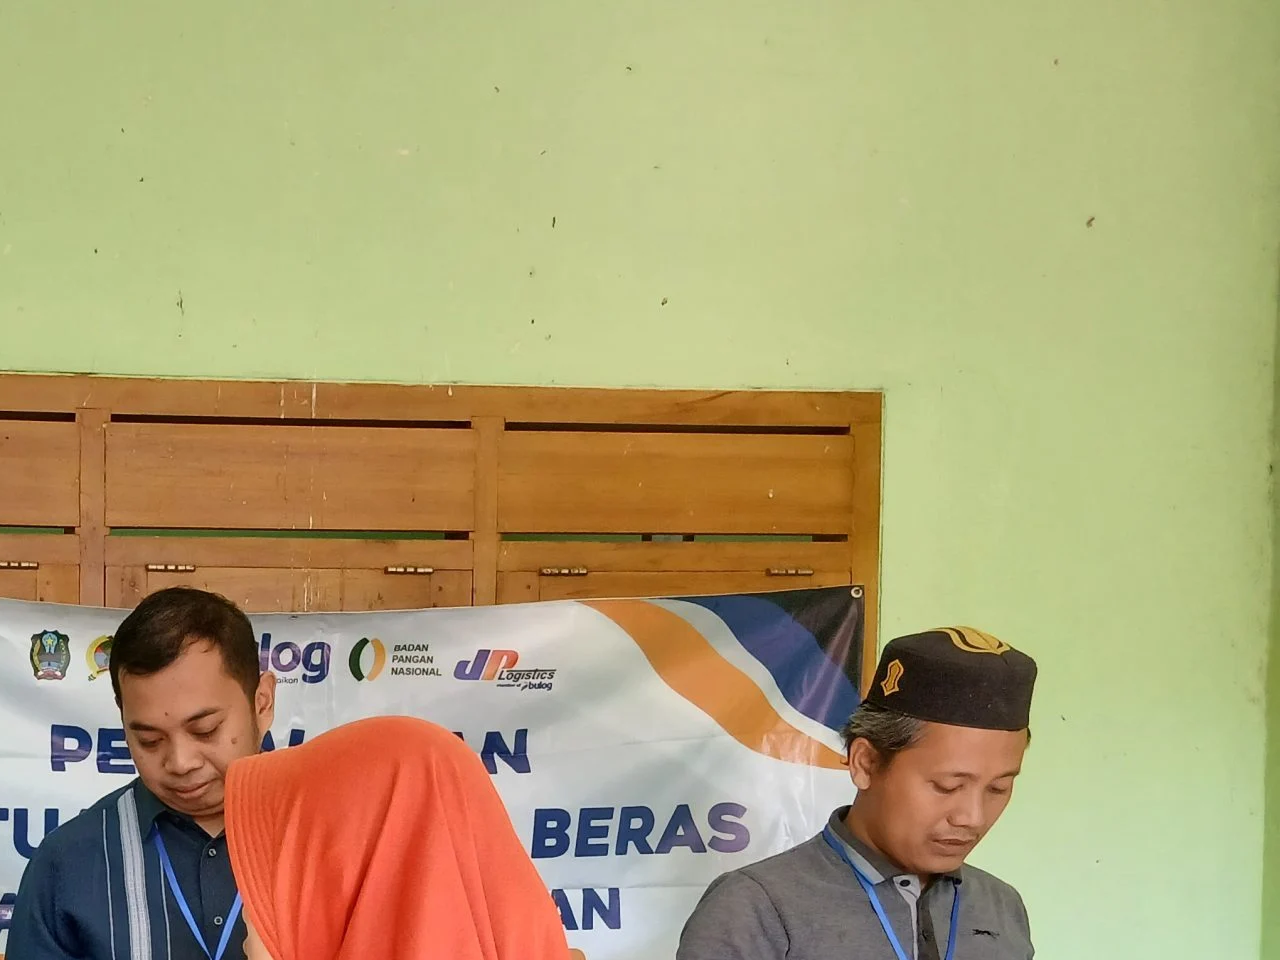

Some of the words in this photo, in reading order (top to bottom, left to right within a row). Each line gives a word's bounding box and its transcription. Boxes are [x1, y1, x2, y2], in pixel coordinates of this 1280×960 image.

[393, 644, 429, 652] BADAN
[256, 633, 331, 684] log
[392, 654, 434, 664] PANGAN
[390, 667, 442, 676] NASIONAL
[498, 669, 556, 682] Logistics
[276, 676, 299, 684] aikan
[528, 681, 553, 691] bulog
[531, 802, 751, 859] BERAS
